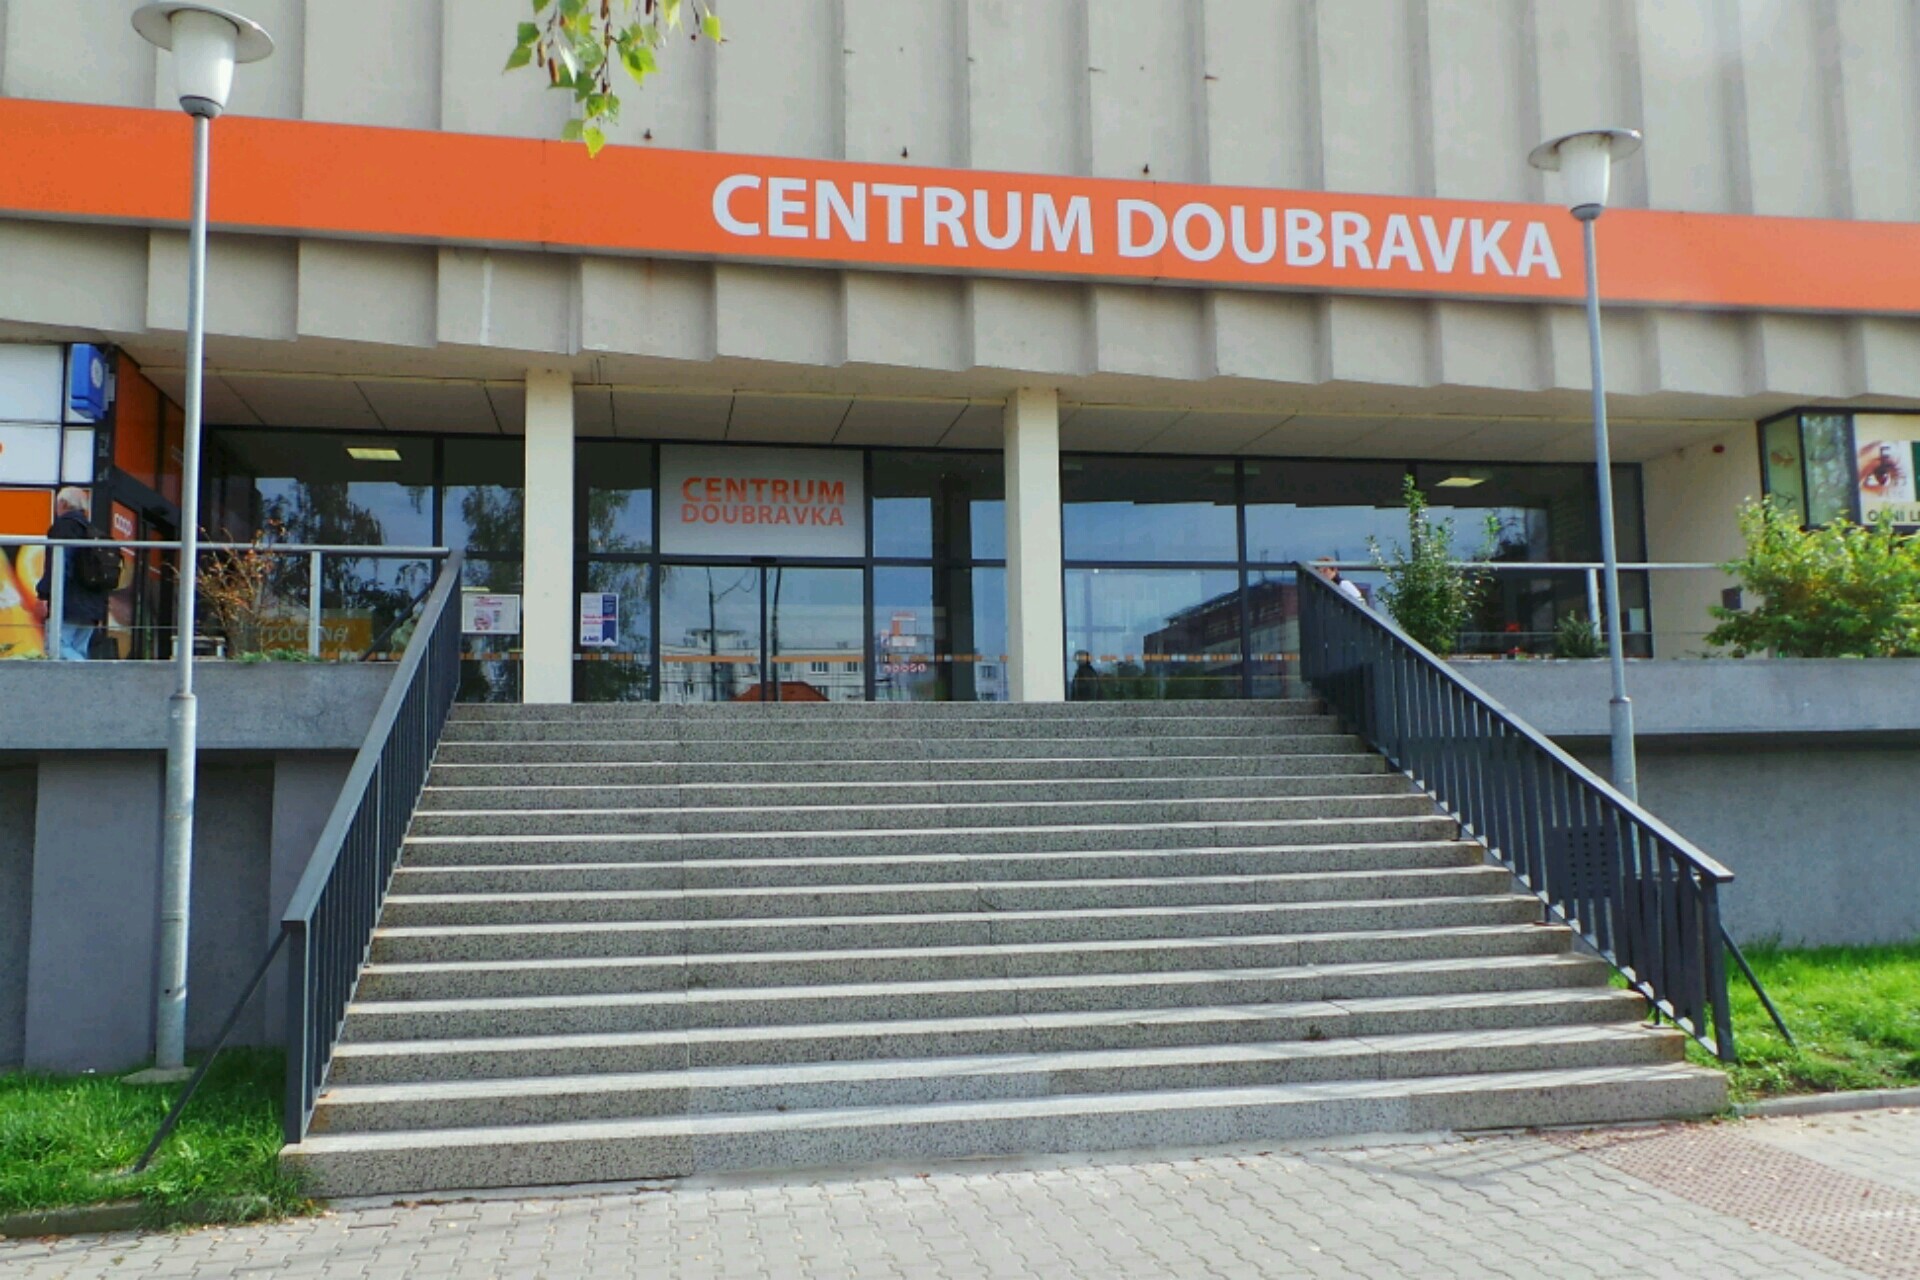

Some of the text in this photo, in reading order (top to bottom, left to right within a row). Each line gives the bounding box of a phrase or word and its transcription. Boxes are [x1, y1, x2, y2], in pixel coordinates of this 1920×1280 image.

[712, 173, 1562, 279] CENTRUM DOUBRAVKA
[682, 477, 846, 505] CENTRUM
[681, 503, 844, 526] DOUBRAVKA
